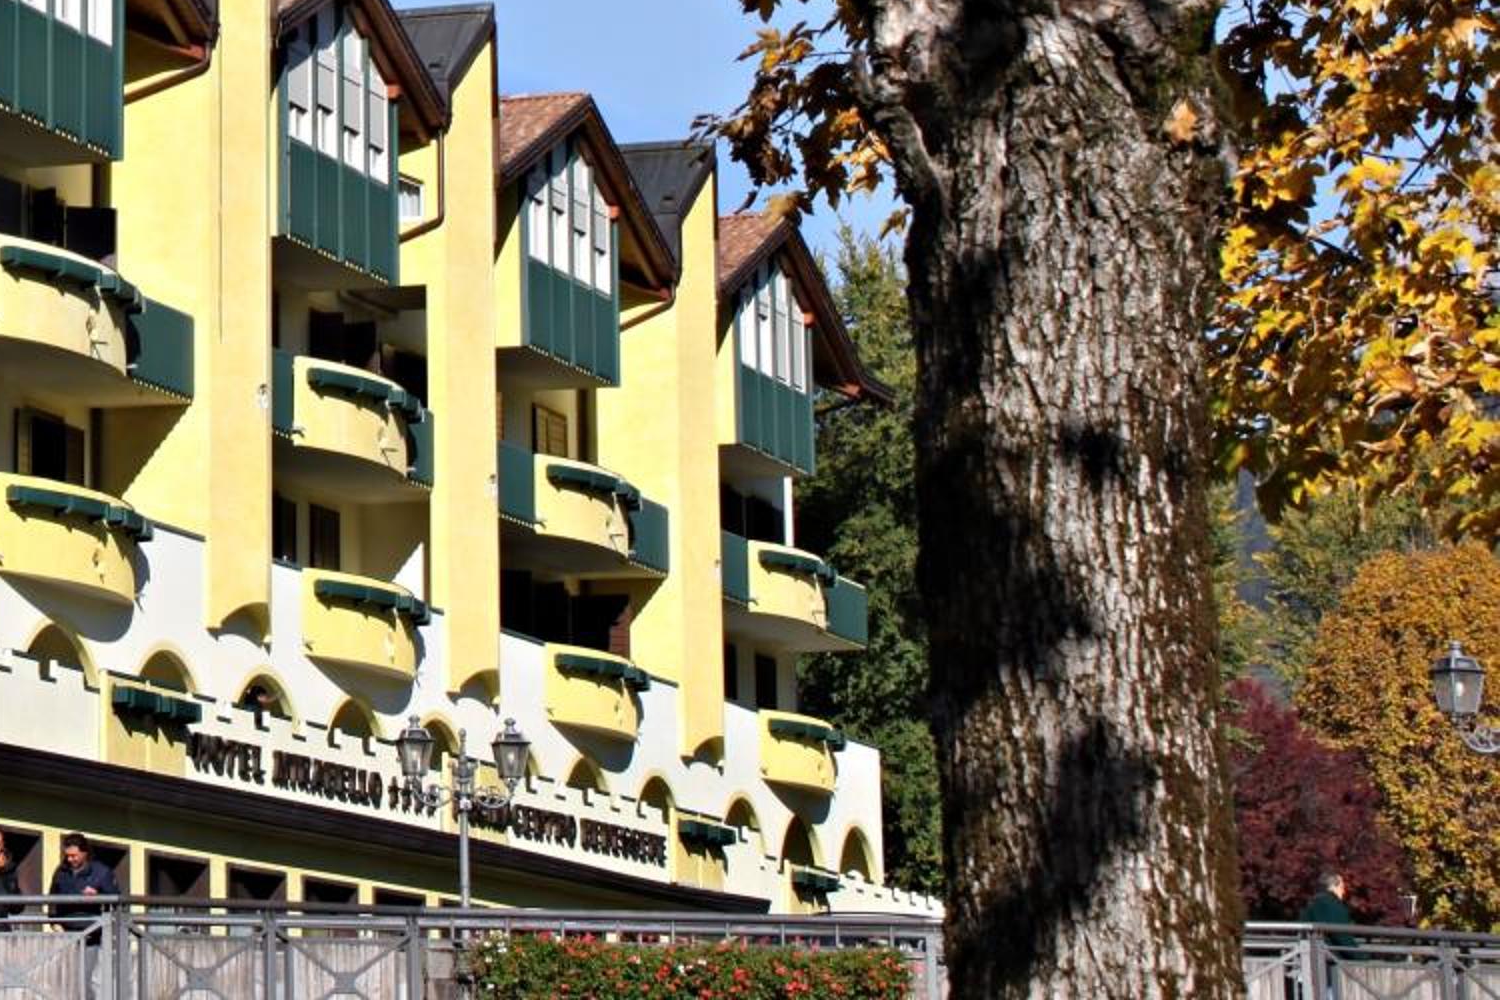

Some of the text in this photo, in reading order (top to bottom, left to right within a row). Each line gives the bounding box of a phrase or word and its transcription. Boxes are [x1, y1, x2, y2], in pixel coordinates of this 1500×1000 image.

[188, 732, 266, 785] HOTEL
[271, 750, 383, 809] MIRABELLO
[509, 803, 577, 849] CENTRO
